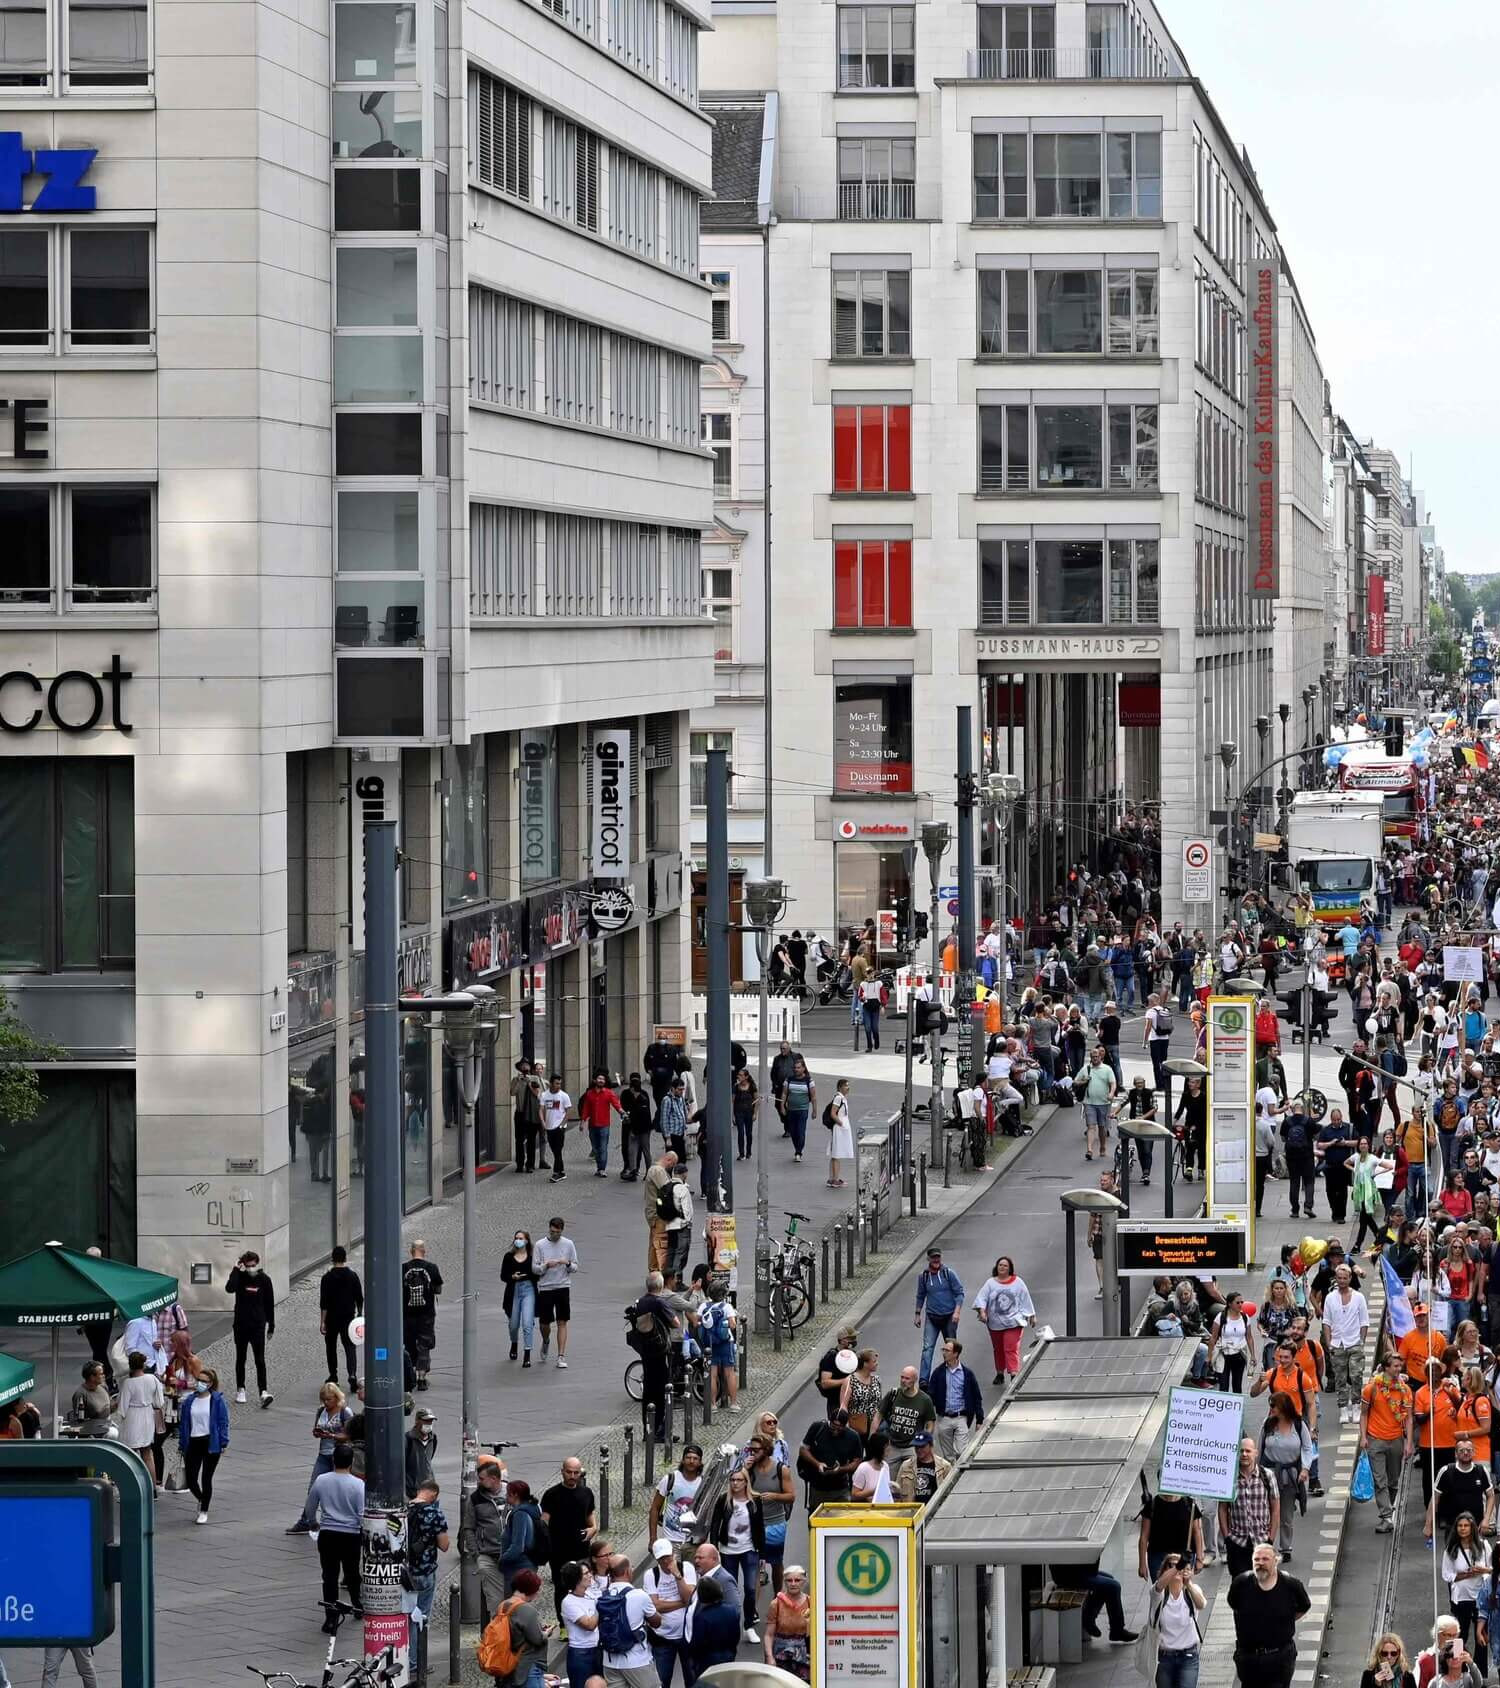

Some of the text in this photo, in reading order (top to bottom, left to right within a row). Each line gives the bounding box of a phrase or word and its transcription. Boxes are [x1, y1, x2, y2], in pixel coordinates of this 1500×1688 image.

[0, 400, 48, 459] E
[1254, 268, 1273, 590] Dussmann das KulturKaufhaus
[976, 639, 1125, 653] DUSSMANN-HAUS
[872, 724, 888, 732] Uhr
[849, 740, 860, 748] Sa
[883, 750, 899, 759] Uhr
[850, 772, 899, 781] Dussmann
[597, 741, 624, 867] ginatricot
[859, 823, 909, 835] vodafone
[17, 1311, 111, 1324] STARBUCKS COFFEE
[1199, 1397, 1242, 1412] gegen
[1185, 1409, 1202, 1417] Form
[1169, 1419, 1203, 1432] Gewalt
[1167, 1433, 1239, 1453] Unterdrückung
[1166, 1446, 1229, 1463] Extremismus
[1164, 1459, 1228, 1476] & Rassismus
[851, 1554, 877, 1584] H
[0, 1595, 34, 1622] ße
[371, 1620, 406, 1629] Sommer
[835, 1614, 845, 1622] M1
[835, 1639, 845, 1647] M1
